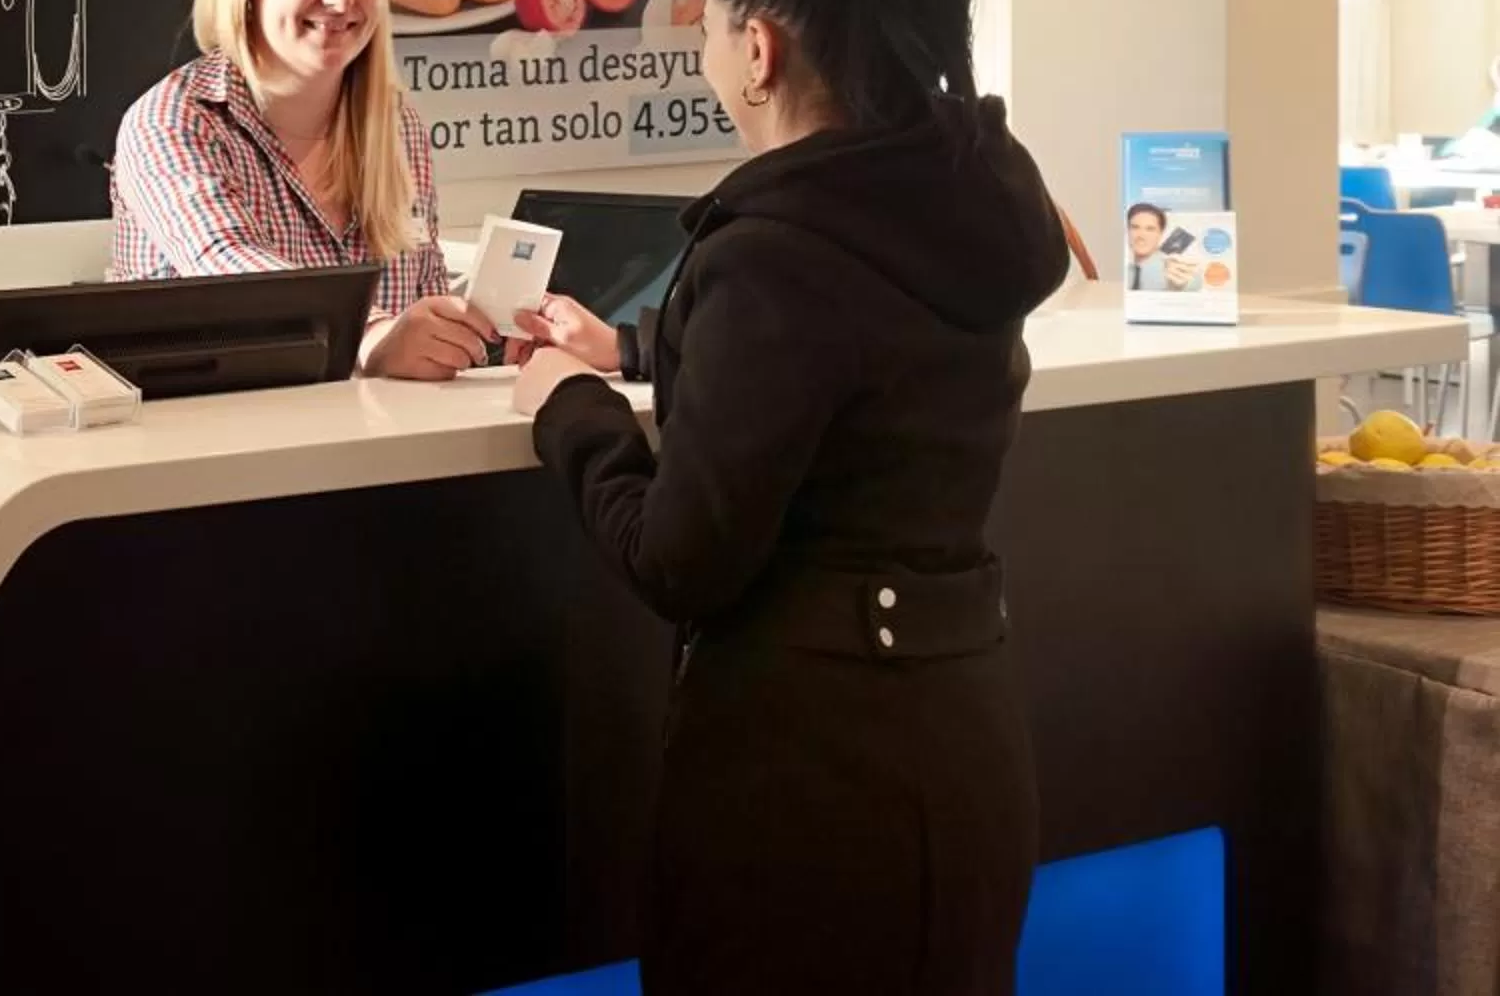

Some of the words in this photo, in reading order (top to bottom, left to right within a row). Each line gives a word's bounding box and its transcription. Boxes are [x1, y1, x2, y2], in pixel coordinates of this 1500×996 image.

[404, 55, 509, 91] Toma
[521, 57, 568, 85] un
[579, 44, 703, 89] desayu
[430, 119, 470, 150] or
[480, 111, 542, 147] tan
[551, 101, 623, 143] solo
[633, 96, 737, 140] 4.95€
